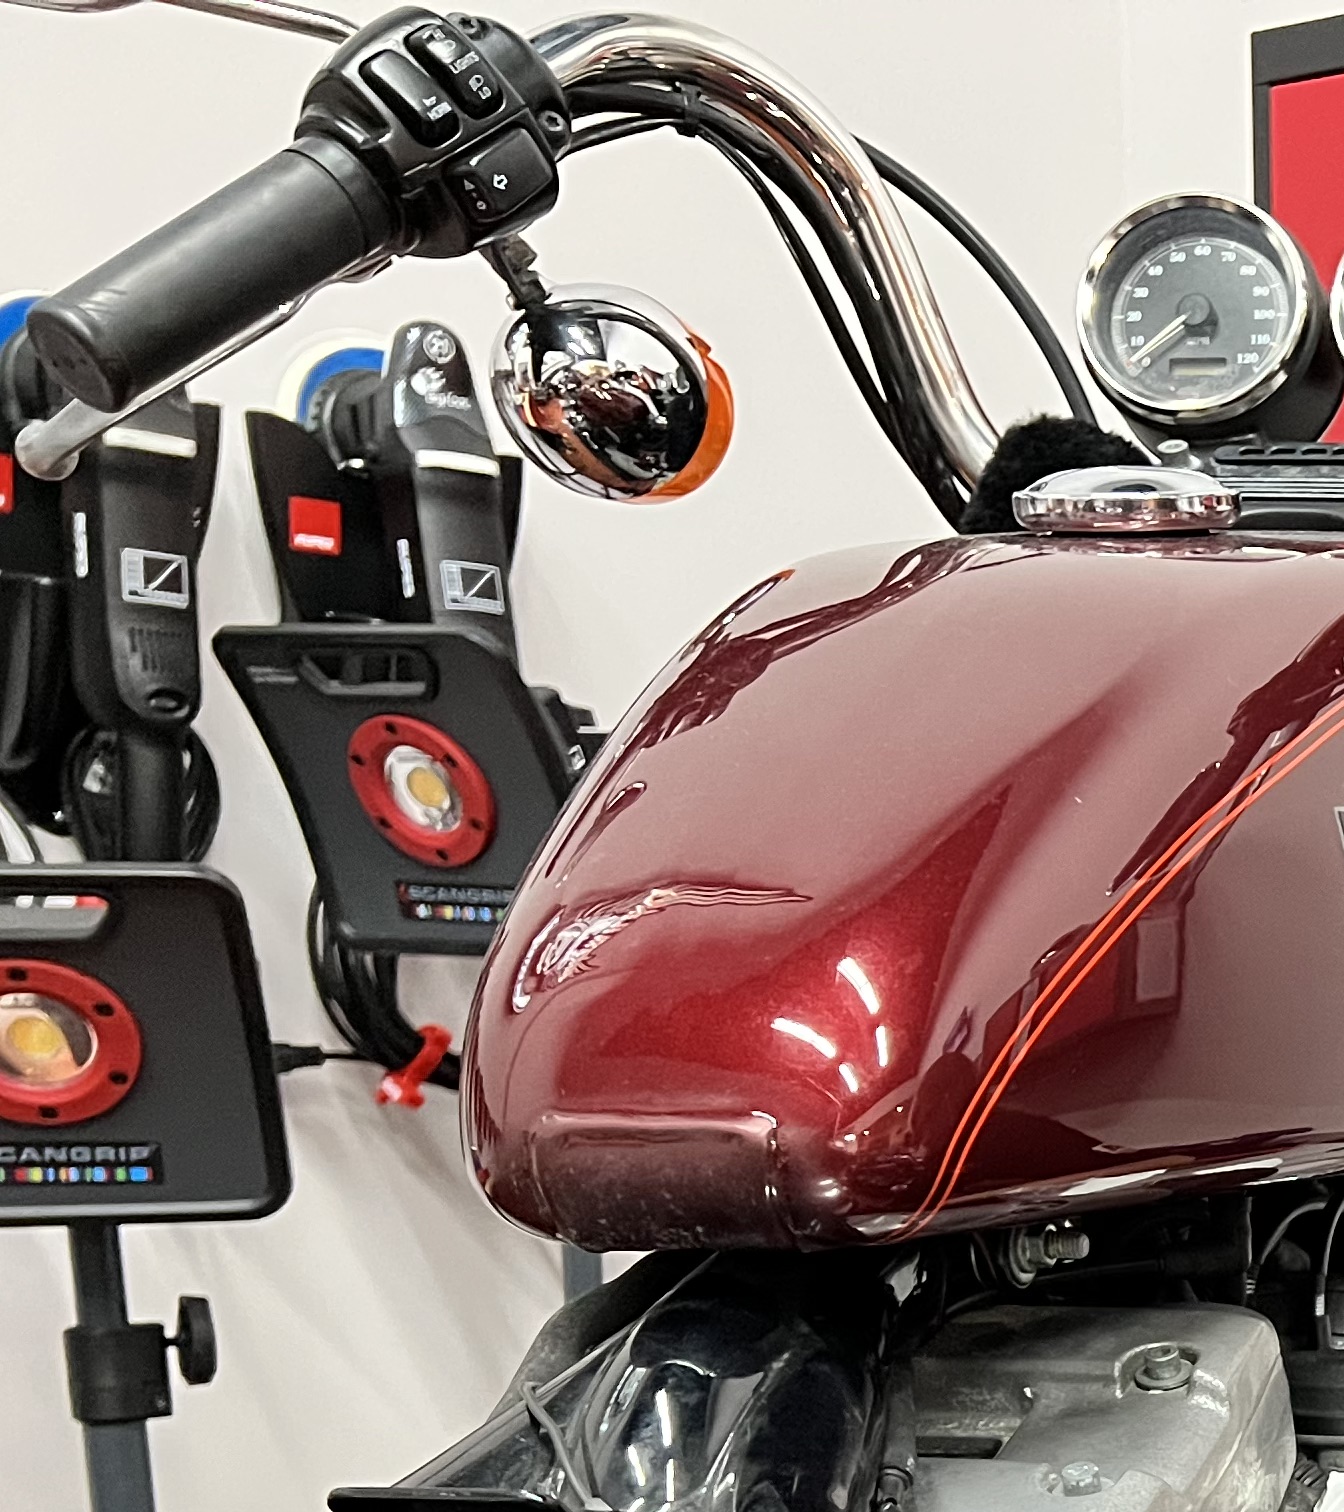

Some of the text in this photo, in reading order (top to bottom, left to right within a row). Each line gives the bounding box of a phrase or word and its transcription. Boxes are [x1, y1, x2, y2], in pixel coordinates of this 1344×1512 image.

[1193, 245, 1212, 256] 60
[1220, 251, 1236, 262] 70
[1147, 265, 1164, 276] 40
[1239, 265, 1257, 276] 80
[1132, 287, 1149, 298] 30
[1252, 286, 1270, 297] 90
[1125, 311, 1143, 322] 20
[1253, 309, 1276, 320] 100
[1130, 335, 1145, 347] 10
[1250, 334, 1271, 345] 110
[1236, 352, 1259, 364] 120
